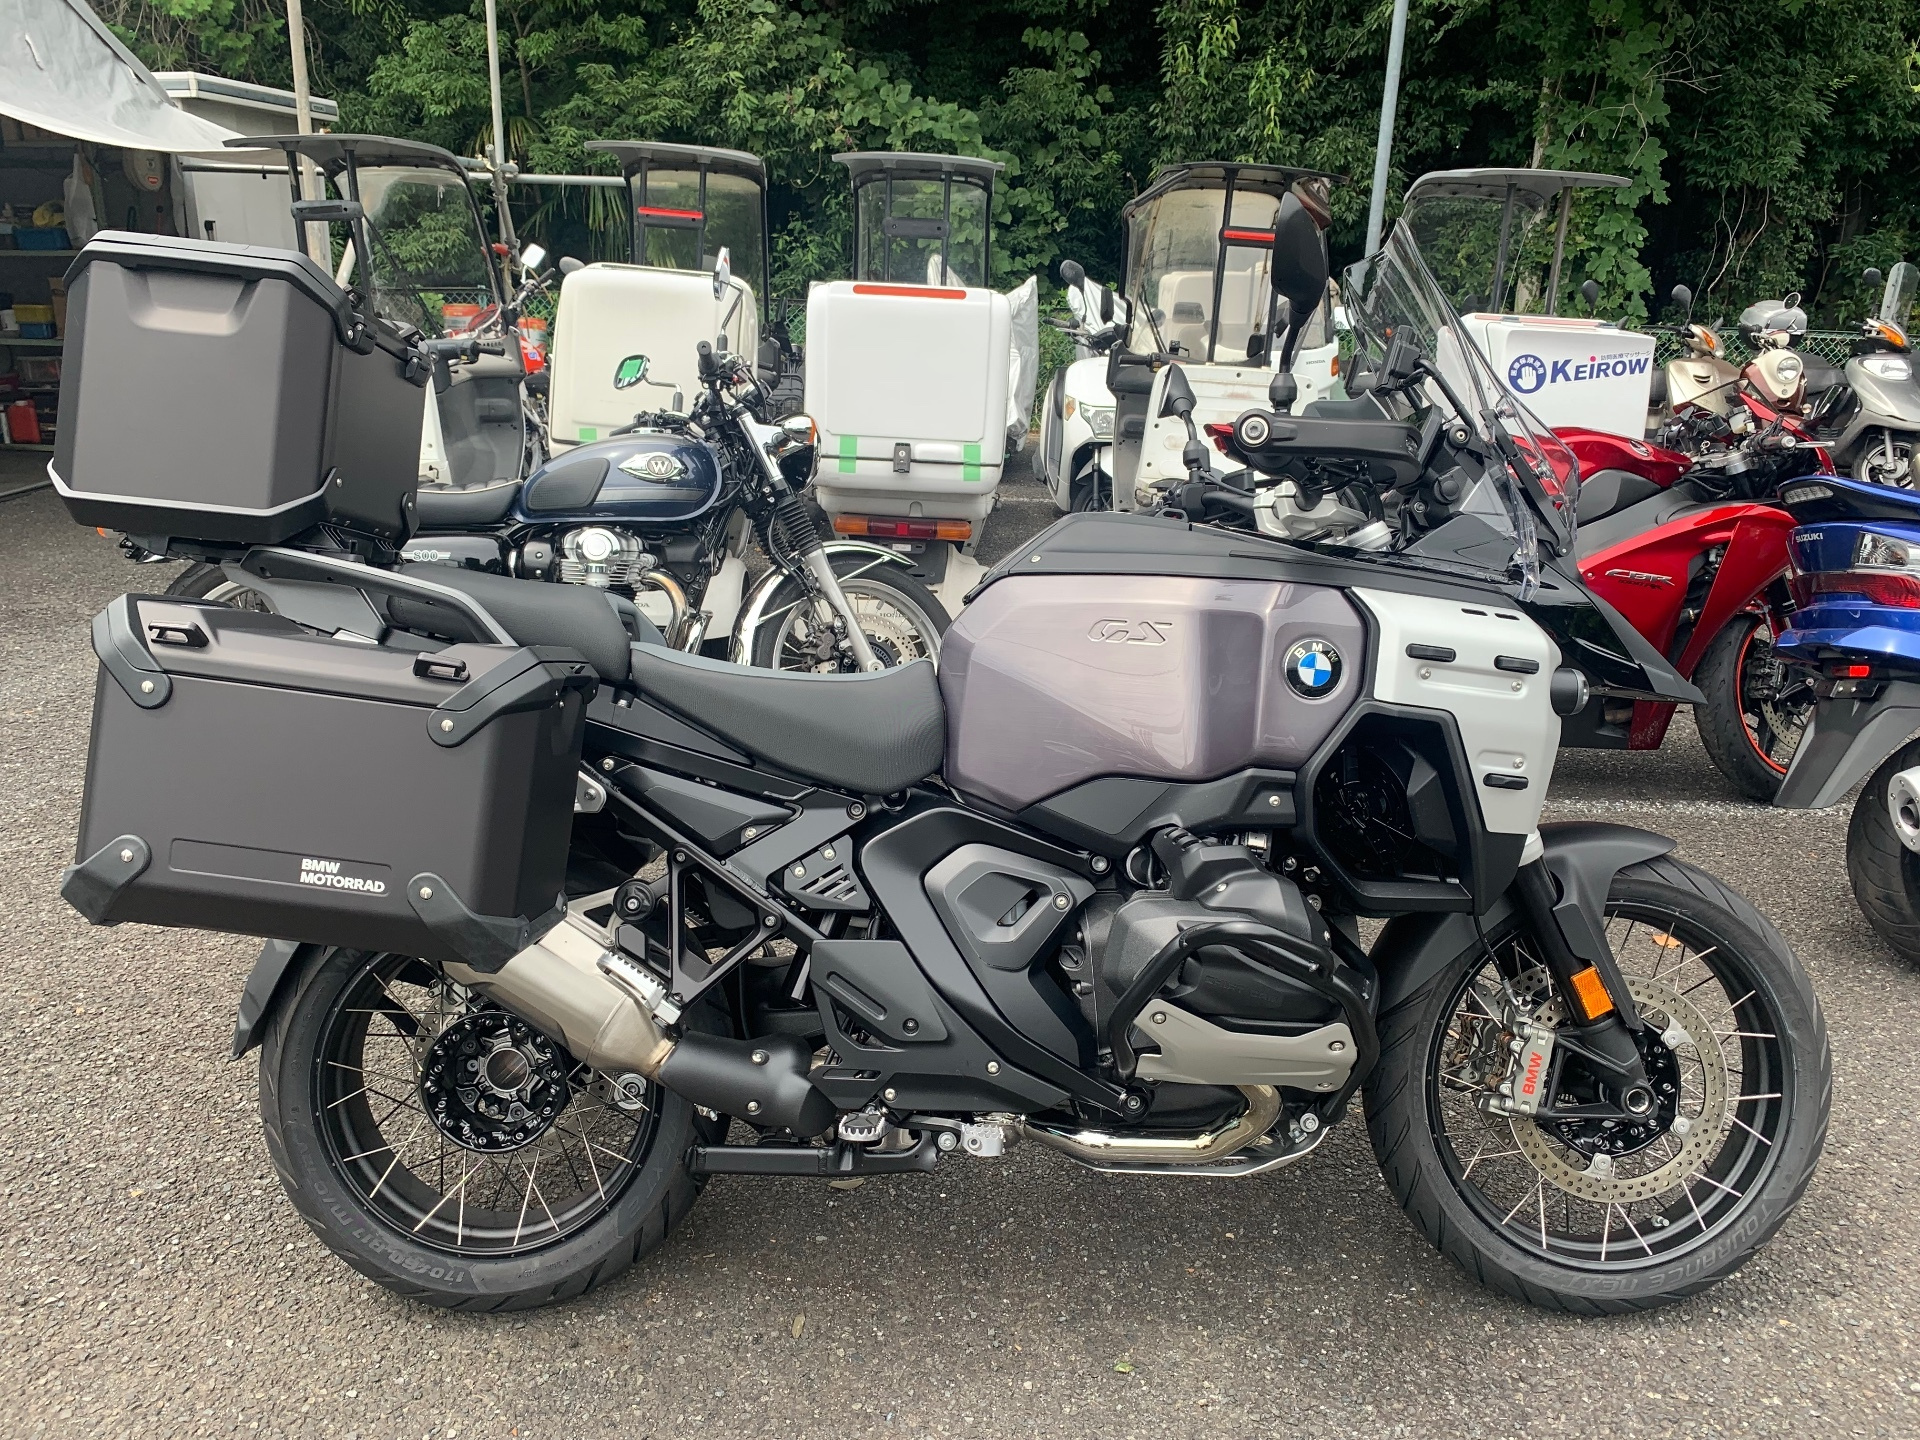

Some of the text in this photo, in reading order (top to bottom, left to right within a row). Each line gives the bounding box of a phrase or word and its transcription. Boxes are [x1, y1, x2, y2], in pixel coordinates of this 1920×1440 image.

[1600, 350, 1651, 361] 訪問医療マッサージ
[650, 460, 669, 474] W
[1795, 532, 1824, 543] SUZUKI
[413, 550, 438, 561] 800
[1604, 568, 1676, 587] CBR
[1087, 618, 1173, 646] GS
[1294, 642, 1339, 663] BMW
[301, 858, 340, 874] BMW
[300, 871, 386, 893] MOTORRAD
[1521, 1051, 1543, 1095] BMW
[1647, 1203, 1773, 1286] TOURANCE
